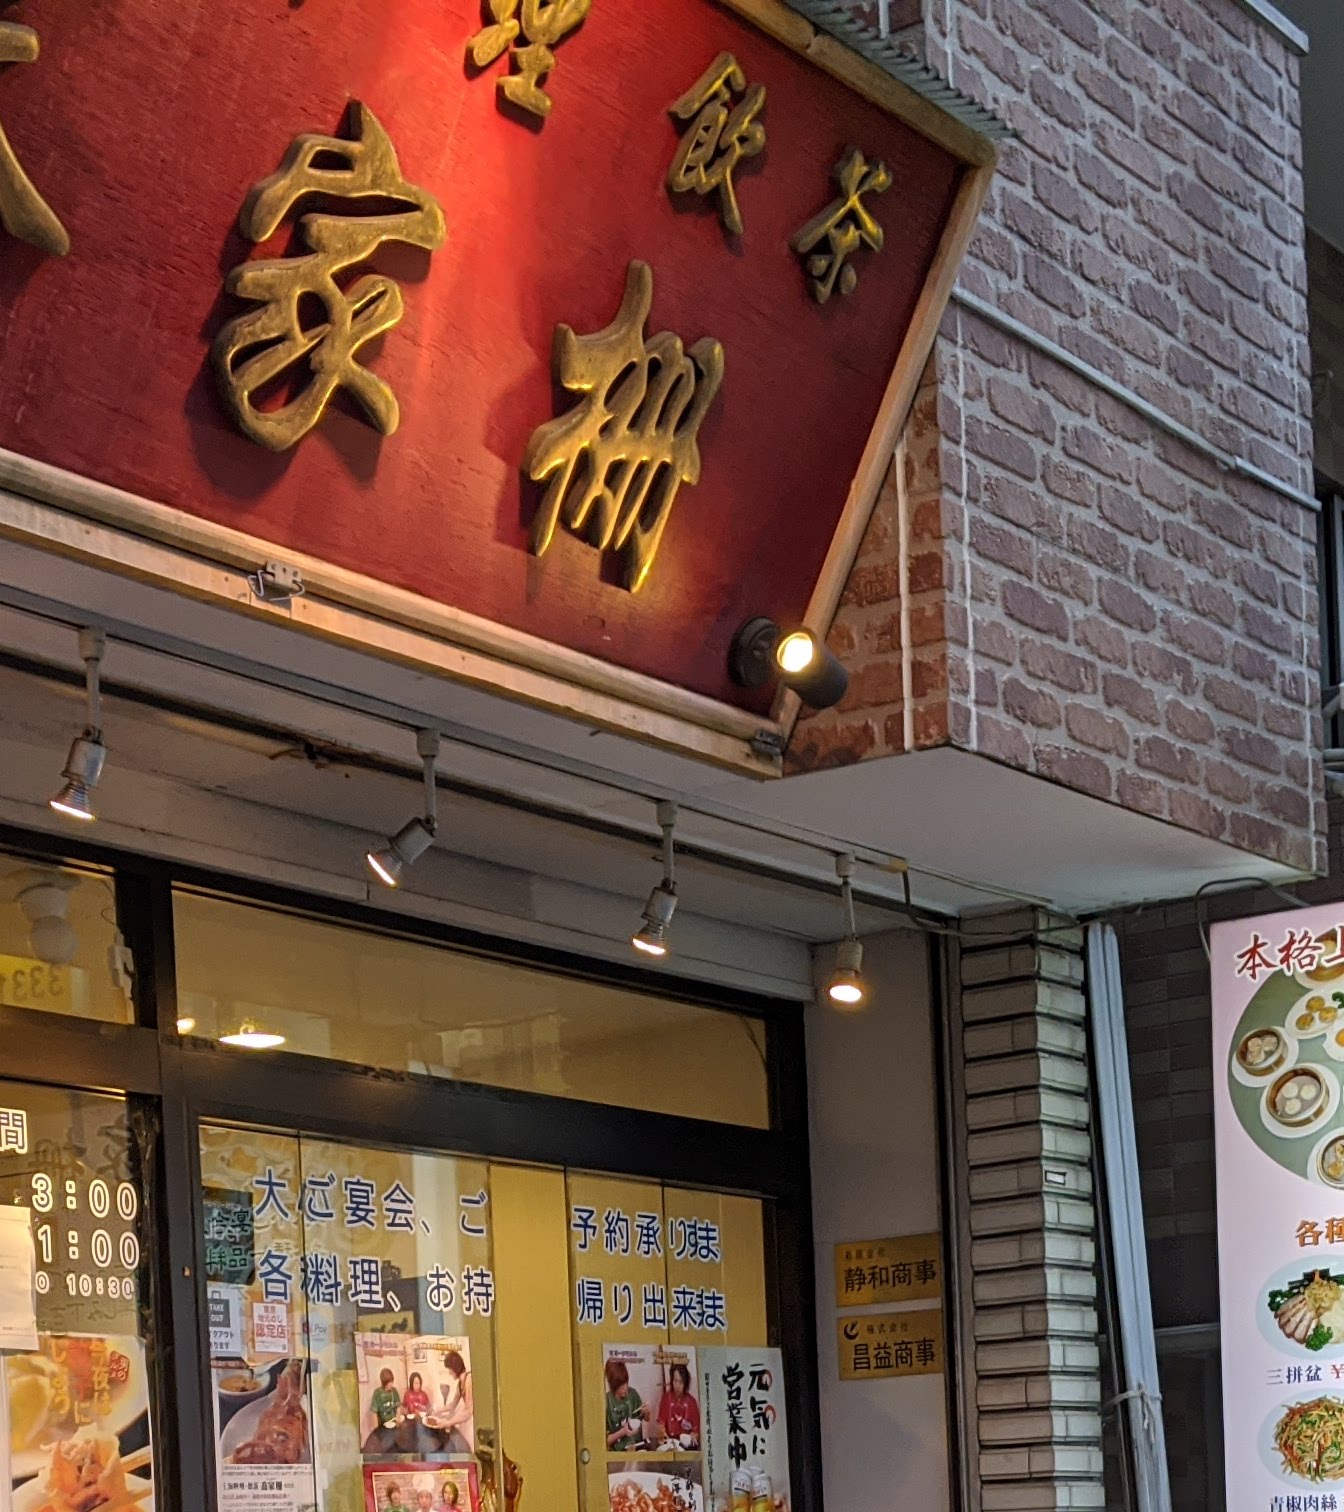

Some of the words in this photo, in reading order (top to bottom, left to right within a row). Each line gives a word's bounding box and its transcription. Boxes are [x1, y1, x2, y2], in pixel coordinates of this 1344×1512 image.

[844, 1259, 937, 1293] 静和商事
[853, 1337, 936, 1371] 昌益商事
[722, 1362, 748, 1468] 営業中
